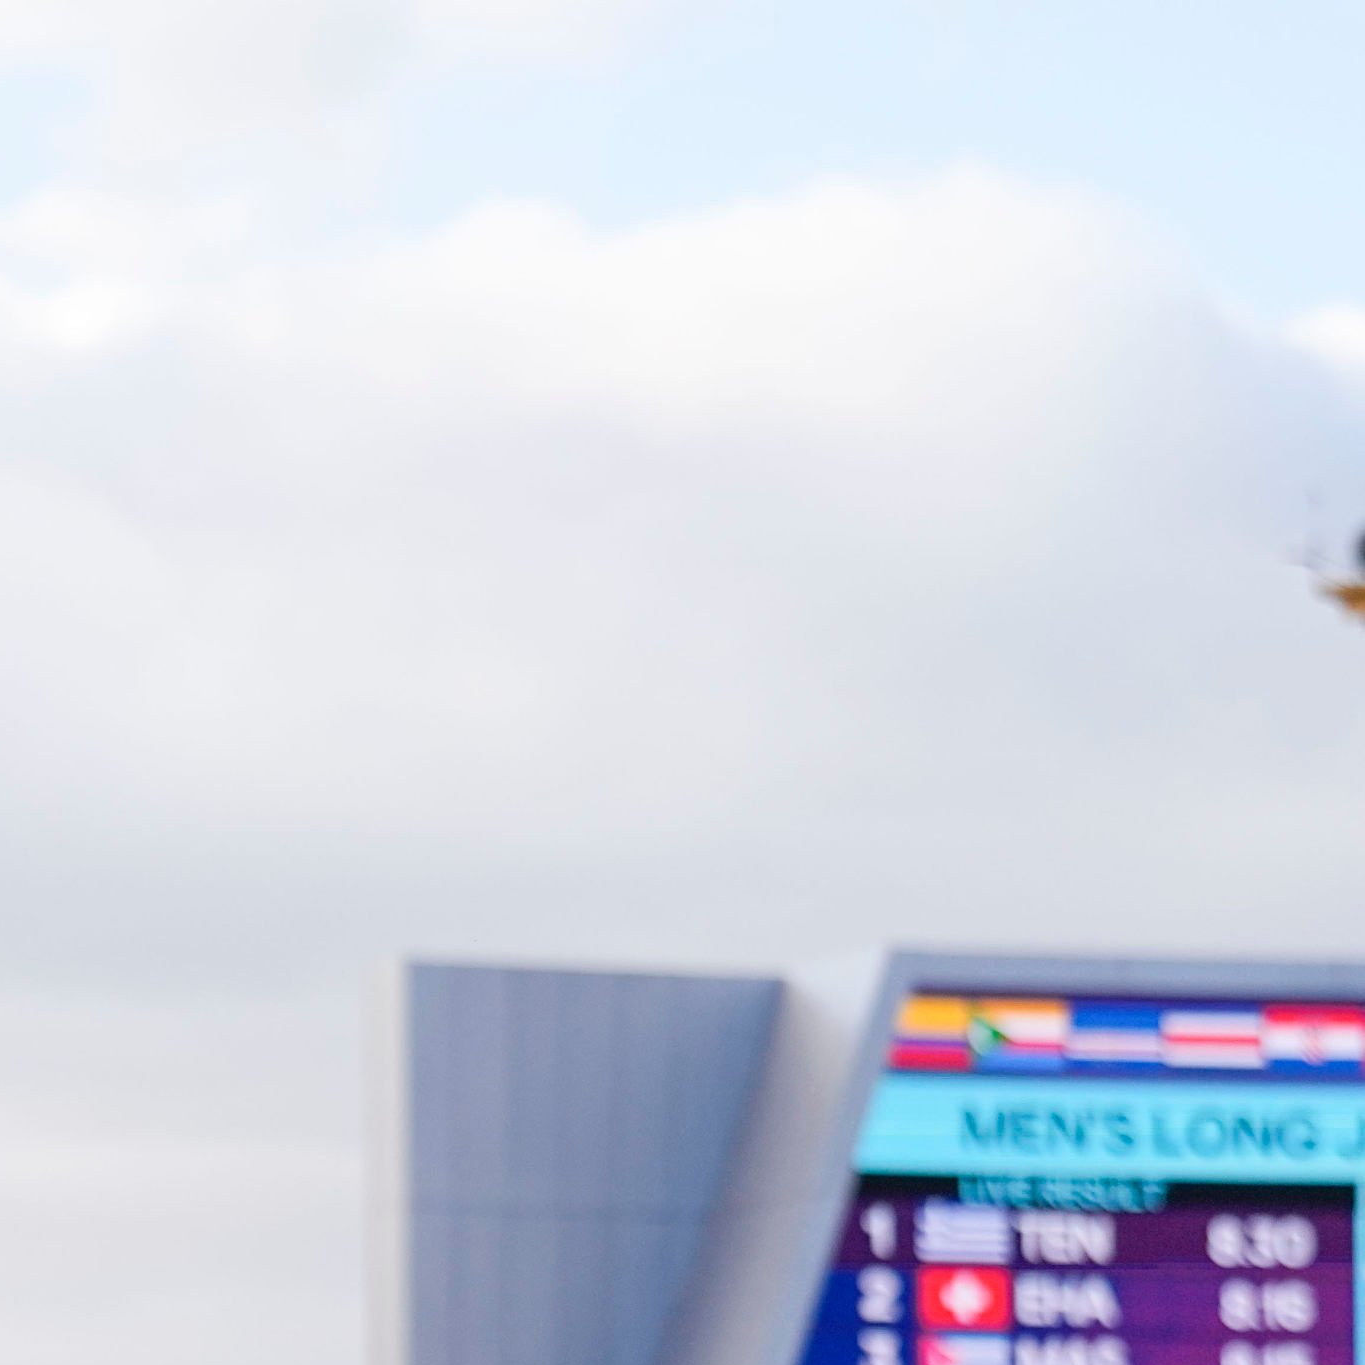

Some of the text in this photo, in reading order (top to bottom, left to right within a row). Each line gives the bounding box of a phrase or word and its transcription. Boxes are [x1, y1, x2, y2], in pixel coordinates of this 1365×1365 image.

[964, 1108, 1136, 1157] MEN'S
[1150, 1112, 1320, 1162] LONG
[860, 1201, 897, 1260] 1
[857, 1265, 903, 1323] 2
